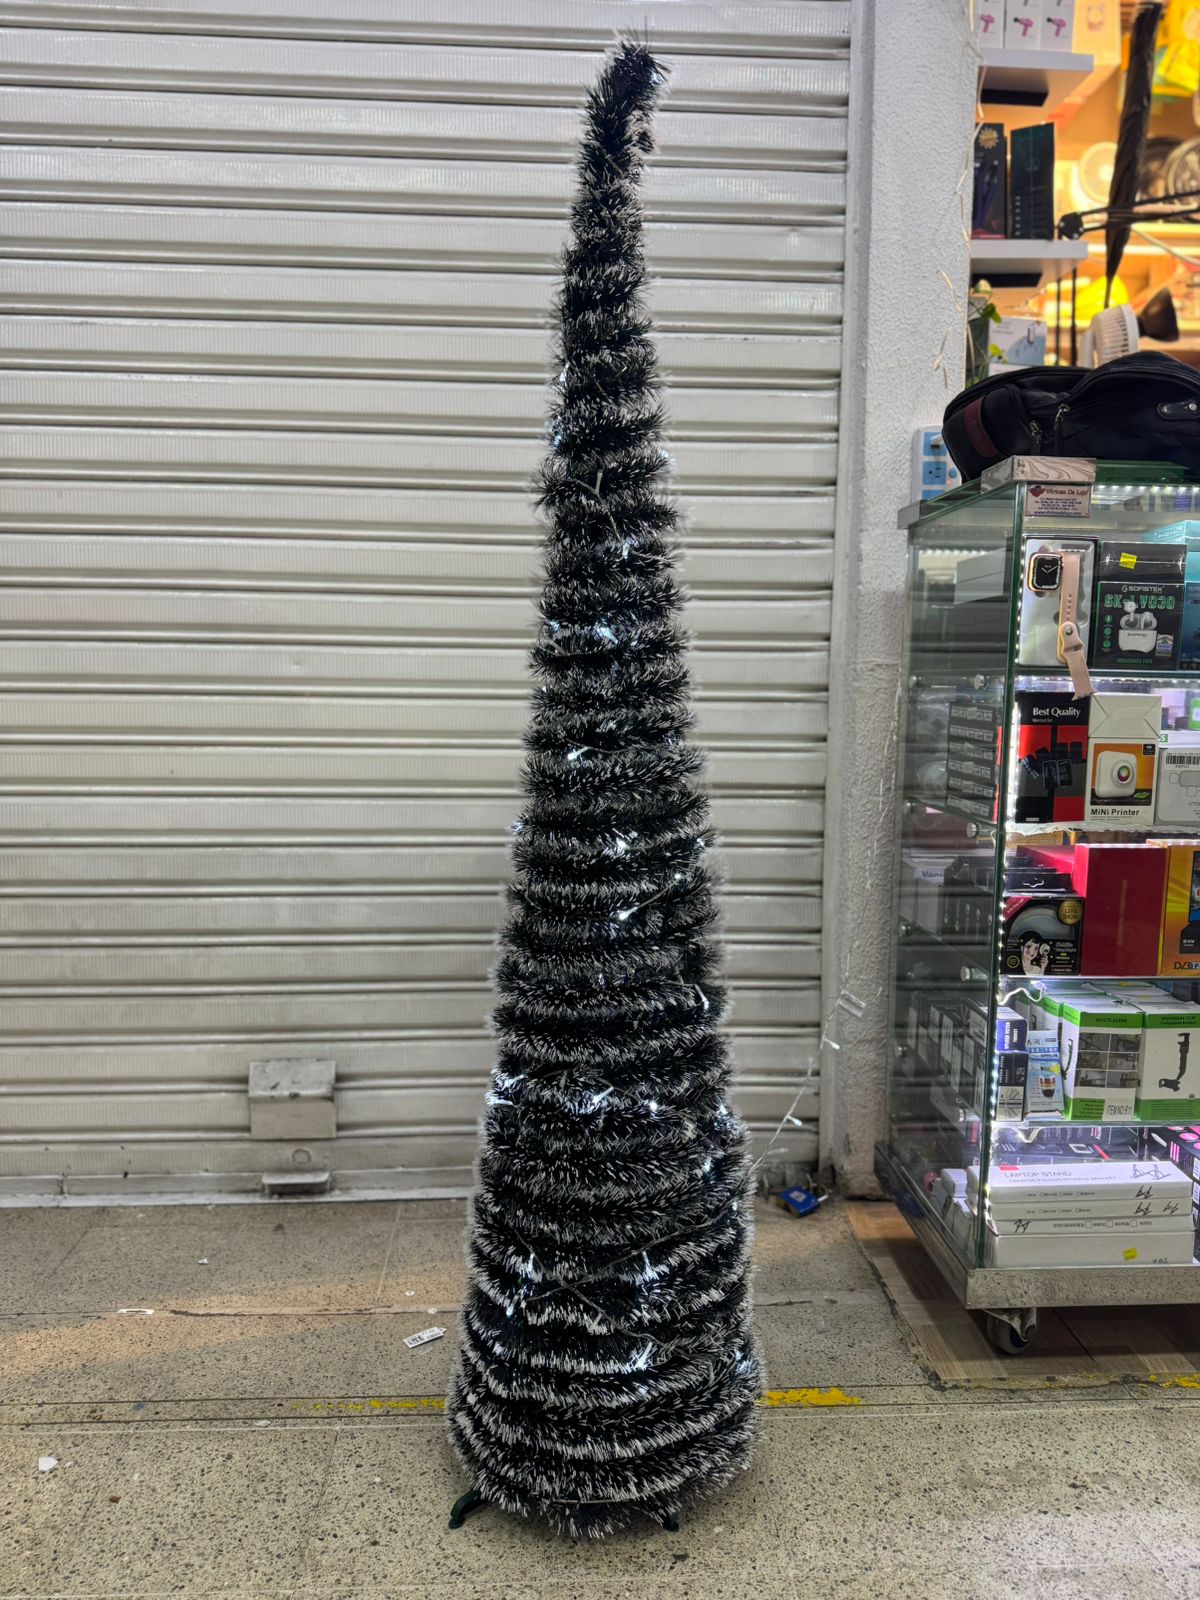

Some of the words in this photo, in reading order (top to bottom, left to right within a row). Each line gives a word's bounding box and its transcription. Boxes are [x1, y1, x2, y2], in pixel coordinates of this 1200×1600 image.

[1032, 707, 1050, 716] Best
[1051, 706, 1081, 719] Quality
[1111, 808, 1140, 816] Printer
